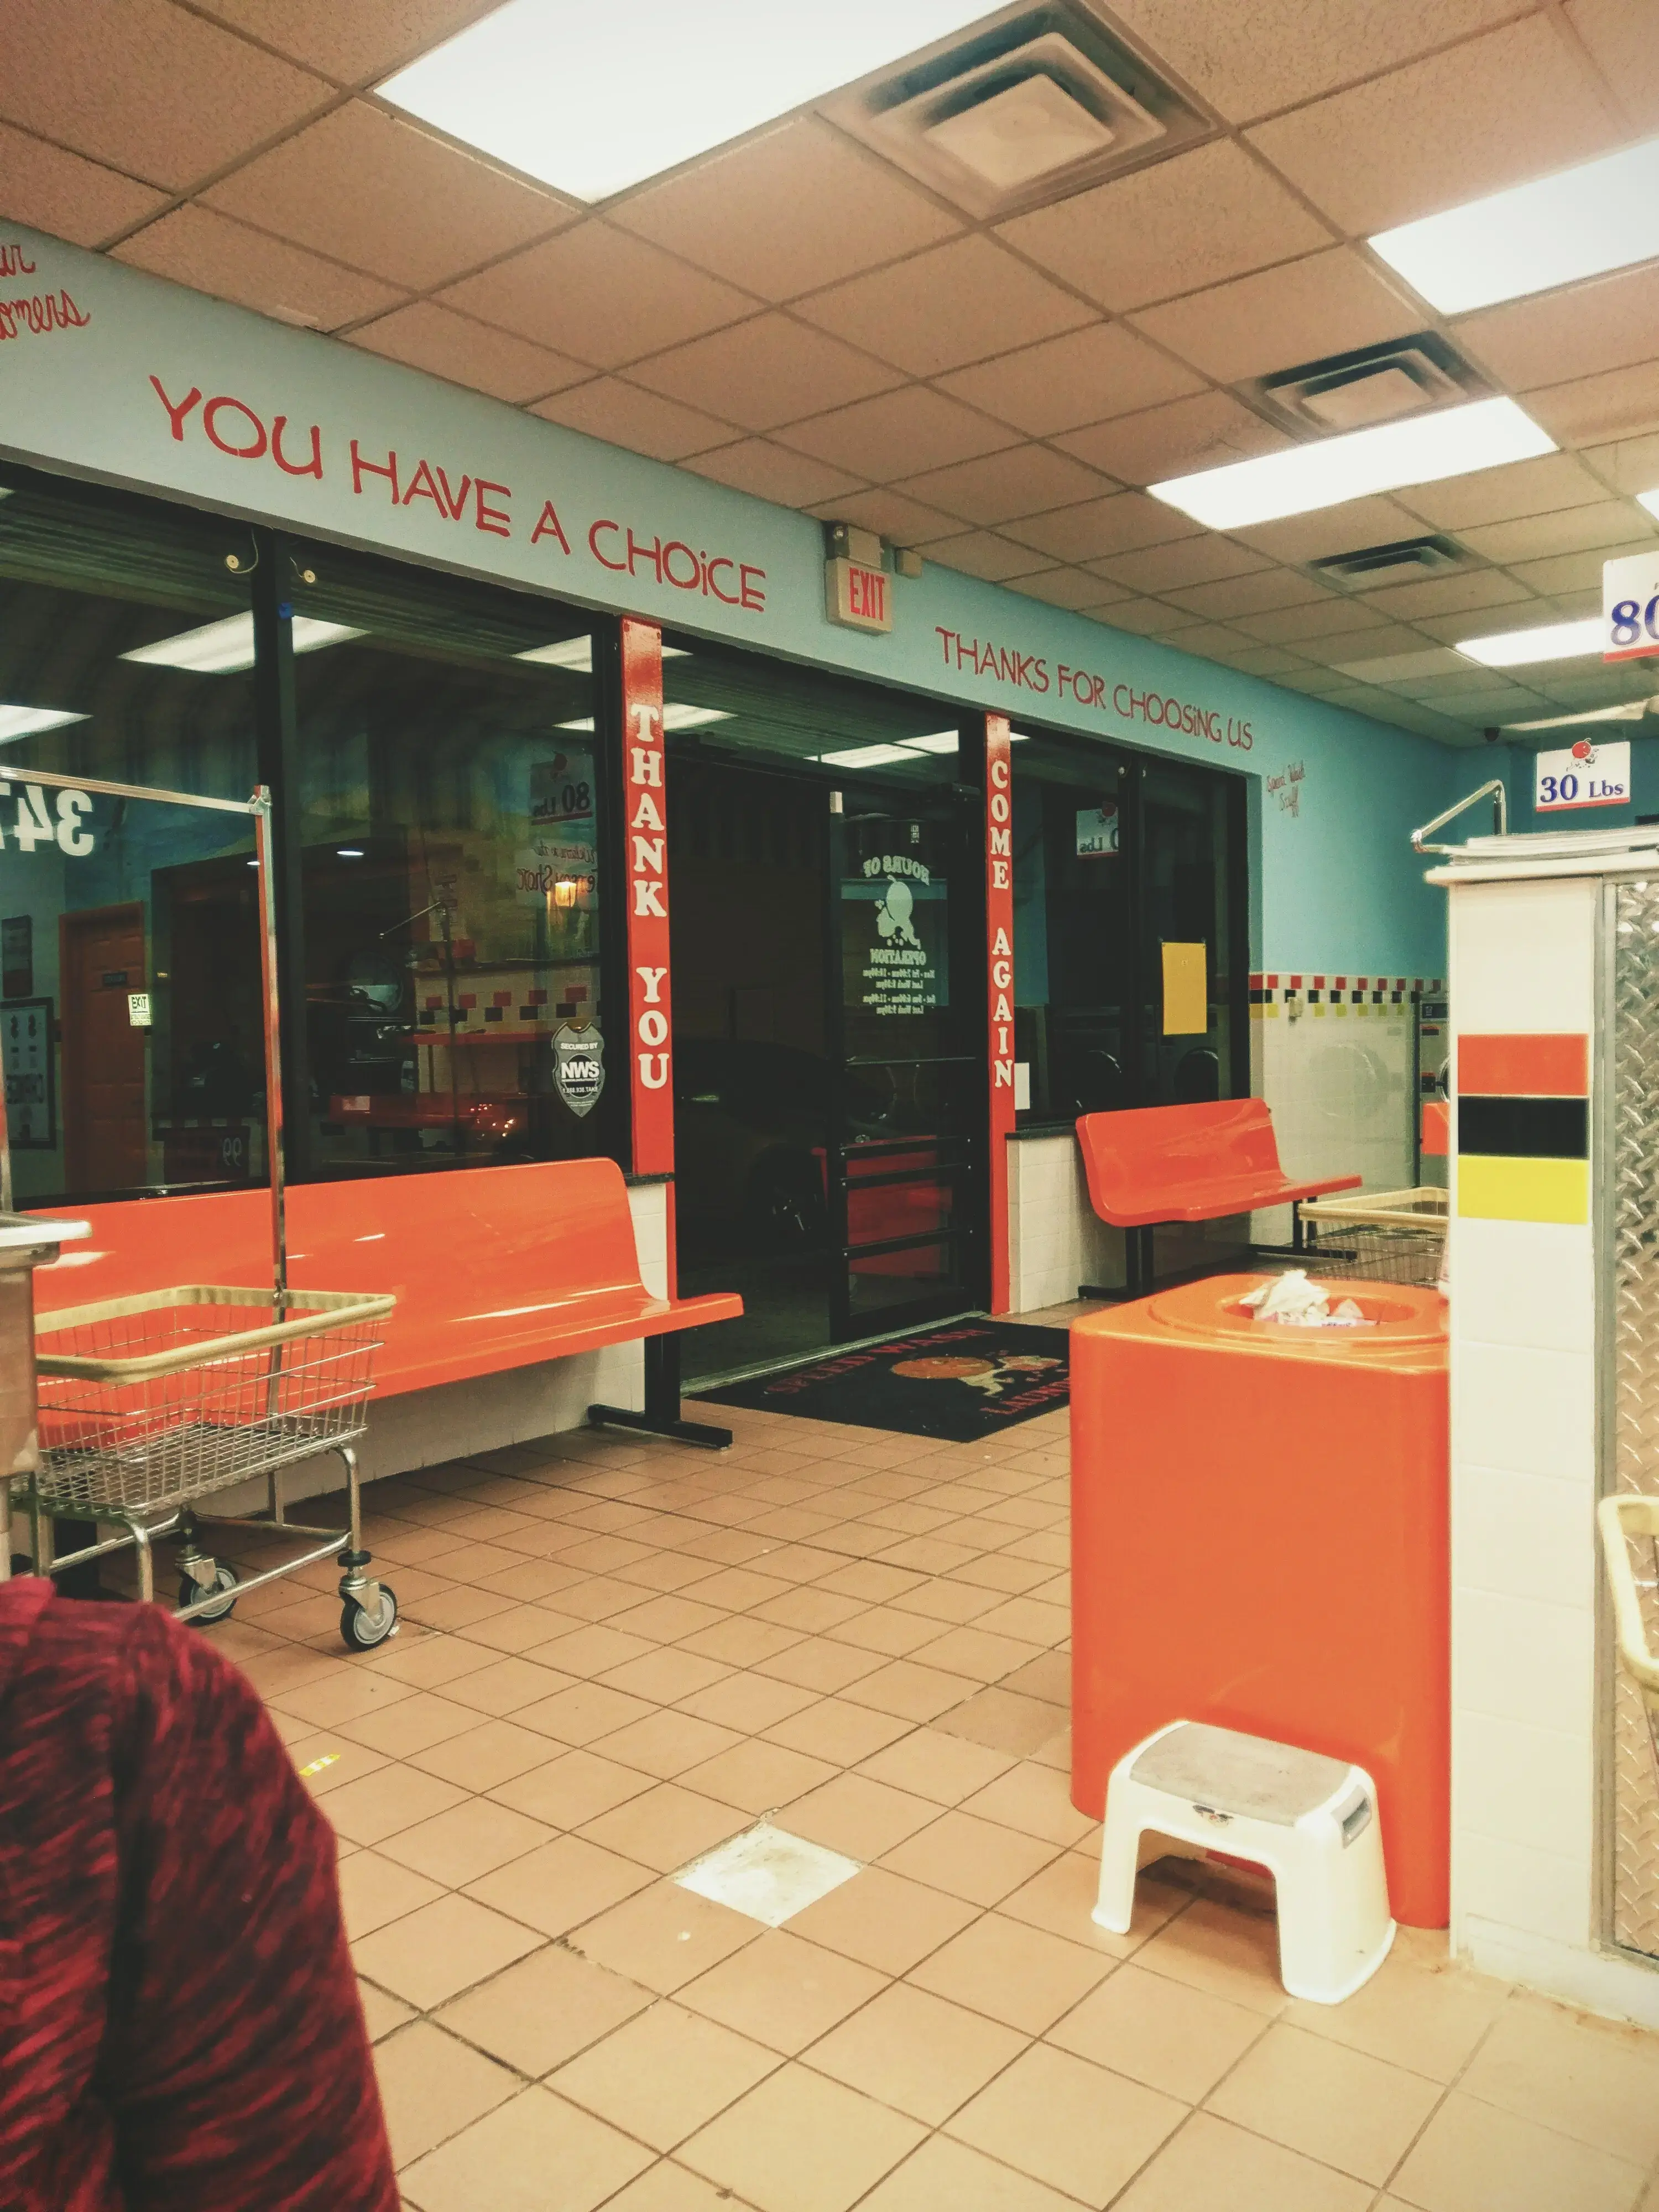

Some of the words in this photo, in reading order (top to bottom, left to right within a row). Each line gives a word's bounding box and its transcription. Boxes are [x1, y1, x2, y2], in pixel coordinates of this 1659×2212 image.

[149, 375, 322, 479] YOU
[350, 440, 511, 537] HAVE
[531, 500, 570, 555] A
[849, 567, 885, 622] EXIT
[935, 626, 1049, 693] THANKS
[1058, 664, 1105, 709] FOR
[1227, 718, 1253, 750] US
[630, 703, 667, 917] THANK
[990, 760, 1011, 889] COME
[1540, 774, 1579, 802] 30
[1588, 780, 1624, 798] Lbs
[131, 996, 147, 1009] EXIT
[636, 967, 669, 1088] YOU
[992, 927, 1013, 1087] AGAIN
[561, 1061, 600, 1079] NWS
